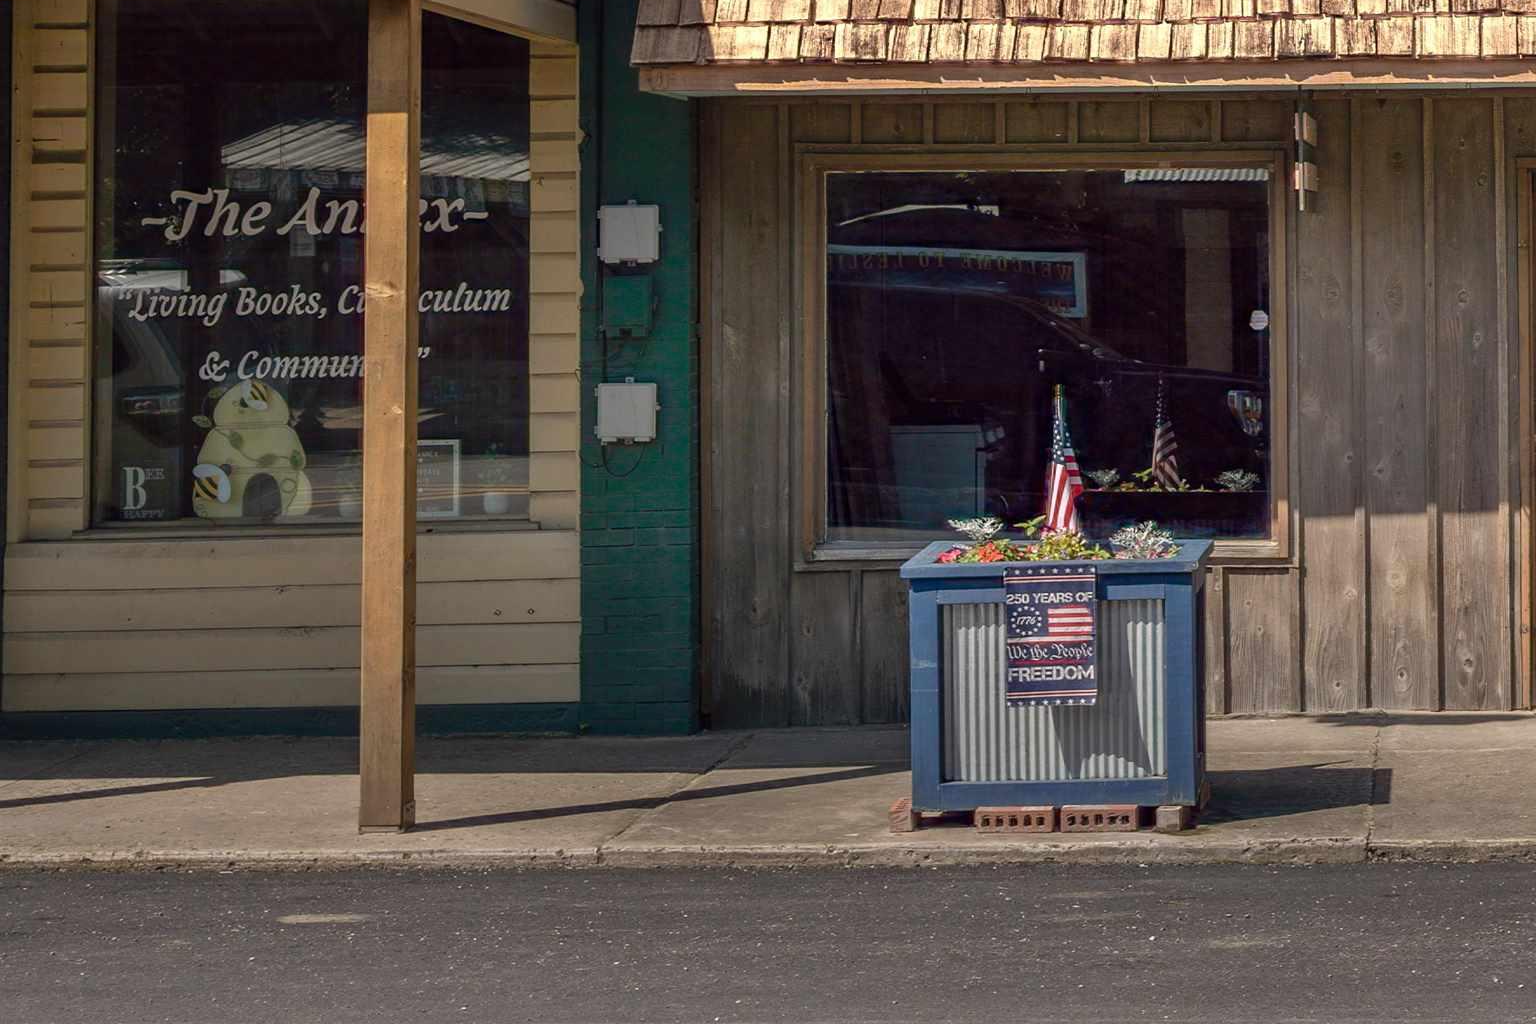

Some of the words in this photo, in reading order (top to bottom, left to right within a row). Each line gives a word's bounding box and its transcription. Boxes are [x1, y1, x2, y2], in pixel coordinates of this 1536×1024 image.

[276, 186, 490, 236] Anx-
[235, 284, 328, 319] Books,
[337, 282, 511, 315] Cculum
[199, 351, 230, 382] &
[1006, 593, 1030, 604] 250
[1033, 592, 1073, 603] YEARS
[1076, 591, 1094, 602] OF
[1016, 615, 1037, 625] 1776
[1007, 646, 1029, 659] We
[1030, 644, 1049, 661] the
[1050, 644, 1094, 659] People
[1008, 665, 1095, 682] FREEDOM
